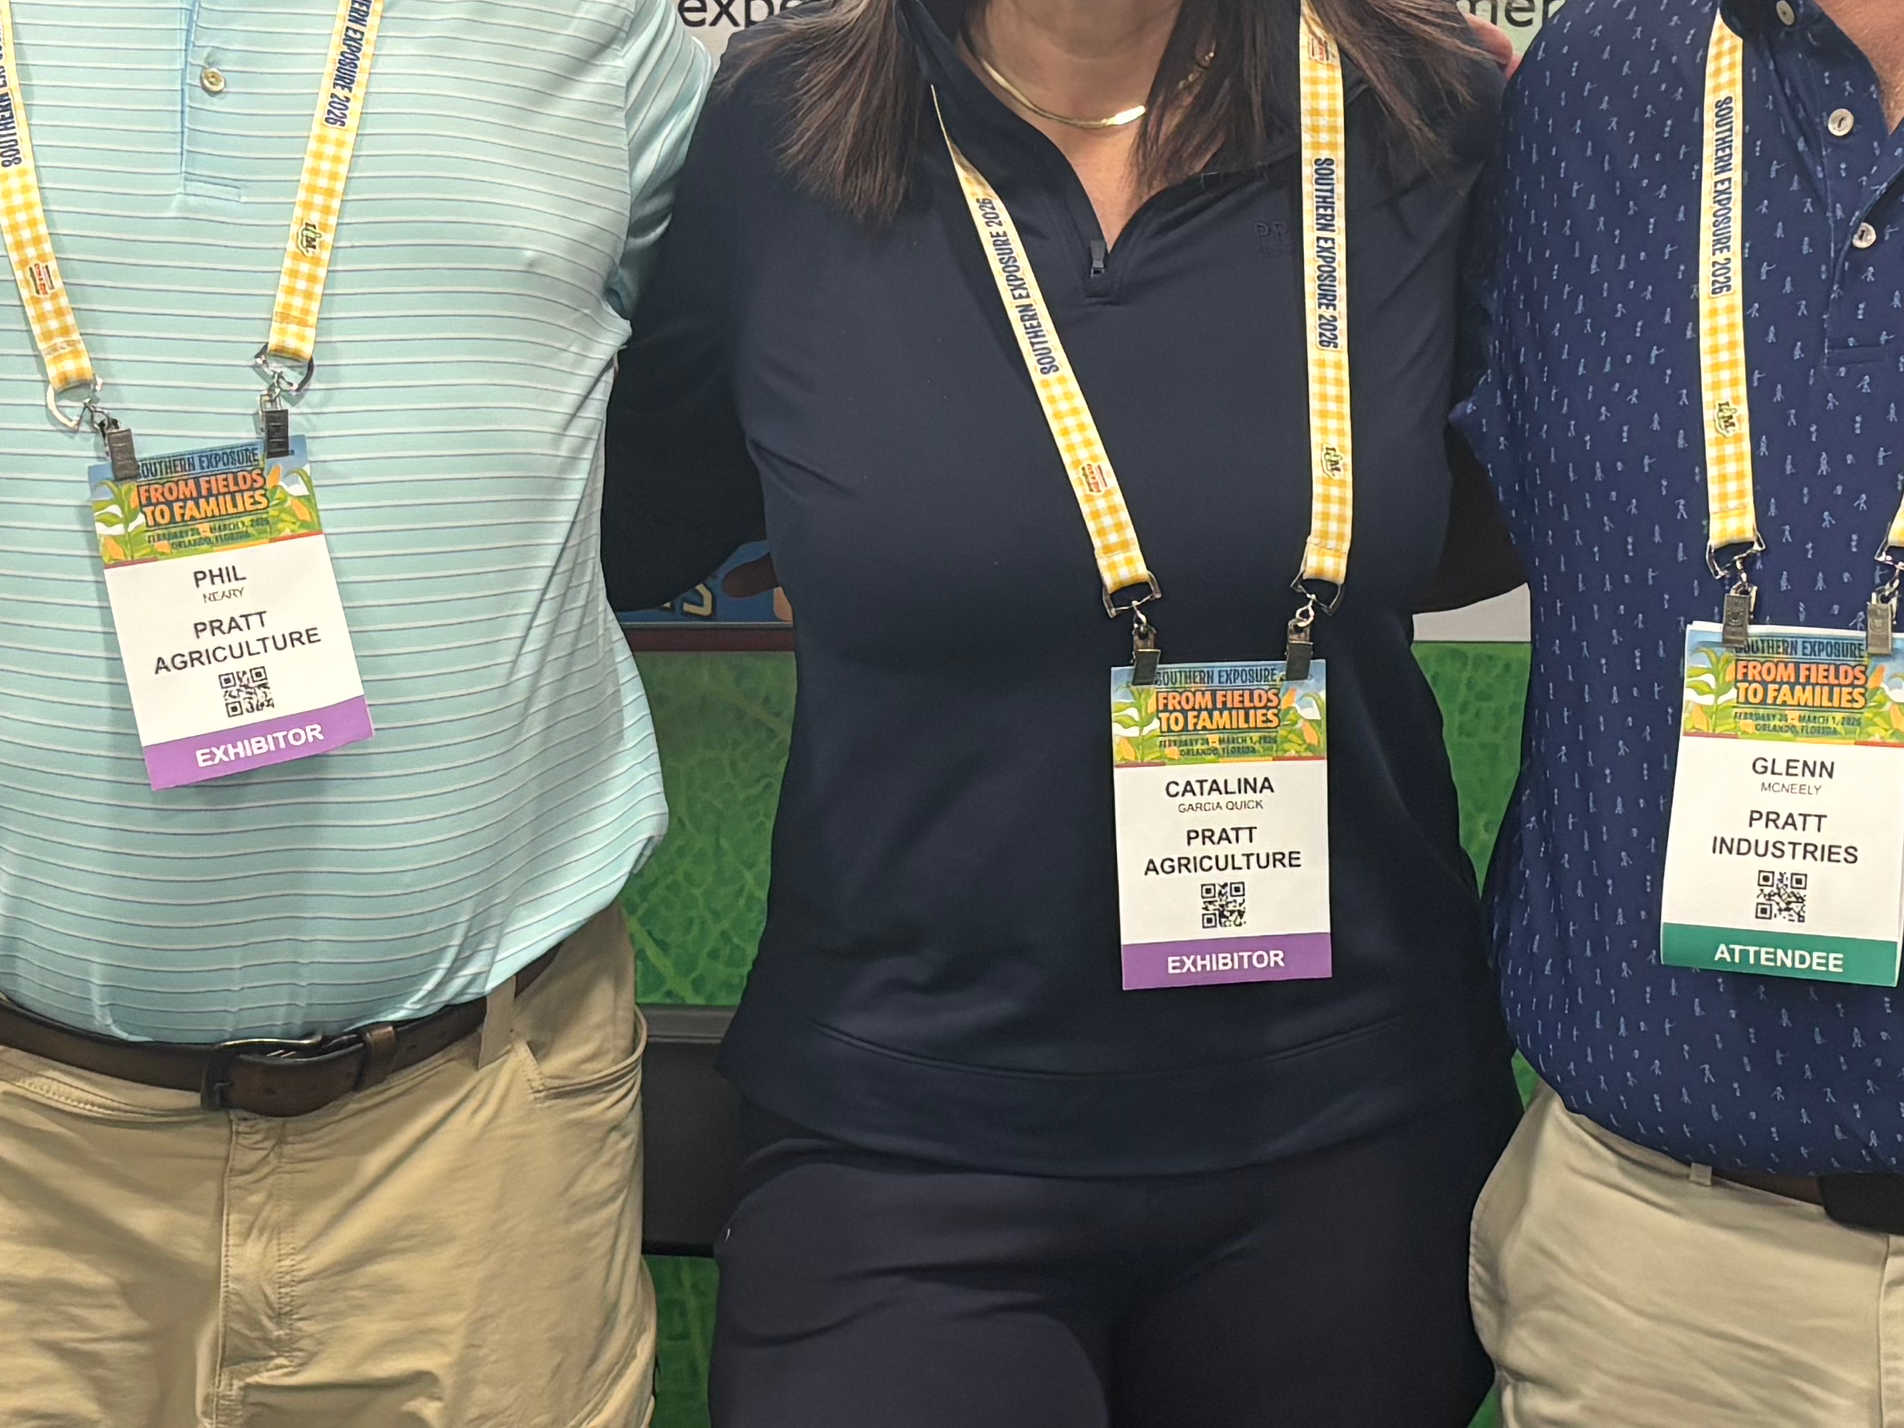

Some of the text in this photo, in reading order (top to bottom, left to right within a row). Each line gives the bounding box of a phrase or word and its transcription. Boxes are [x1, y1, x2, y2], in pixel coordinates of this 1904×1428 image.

[327, 25, 365, 93] EXPOSURE
[324, 88, 350, 128] 2026
[1710, 95, 1733, 296] SOUTHERN EXPOSURE 2026
[1313, 157, 1339, 350] SOUTHERN EXPOSURE 2026
[976, 197, 1060, 376] SOUTHERN EXPOSURE 2026
[198, 447, 260, 471] EXPOSURE
[140, 470, 265, 504] FROM FIELDS
[144, 490, 270, 527] TO FAMILIES
[193, 564, 247, 588] PHIL
[193, 610, 268, 639] PRATT
[154, 626, 322, 675] AGRICULTURE
[1801, 639, 1864, 659] EXPOSURE
[1156, 667, 1278, 687] SOUTHERN EXPOSURE
[1736, 661, 1867, 686] FROM FIELDS
[1157, 688, 1280, 710] FROM FIELDS
[1736, 683, 1866, 710] TO FAMILIES
[1159, 709, 1280, 732] TO FAMILIES
[195, 723, 325, 767] EXHIBITOR
[1751, 756, 1835, 780] GLENN
[1165, 776, 1274, 798] CATALINA
[1760, 782, 1822, 796] MCNEELY
[1225, 799, 1264, 811] QUICK
[1748, 809, 1827, 833] PRATT
[1186, 826, 1257, 846] PRATT
[1711, 835, 1859, 865] INDUSTRIES
[1144, 850, 1302, 876] AGRICULTURE
[1167, 950, 1285, 974] EXHIBITOR
[1714, 943, 1844, 973] ATTENDEE
